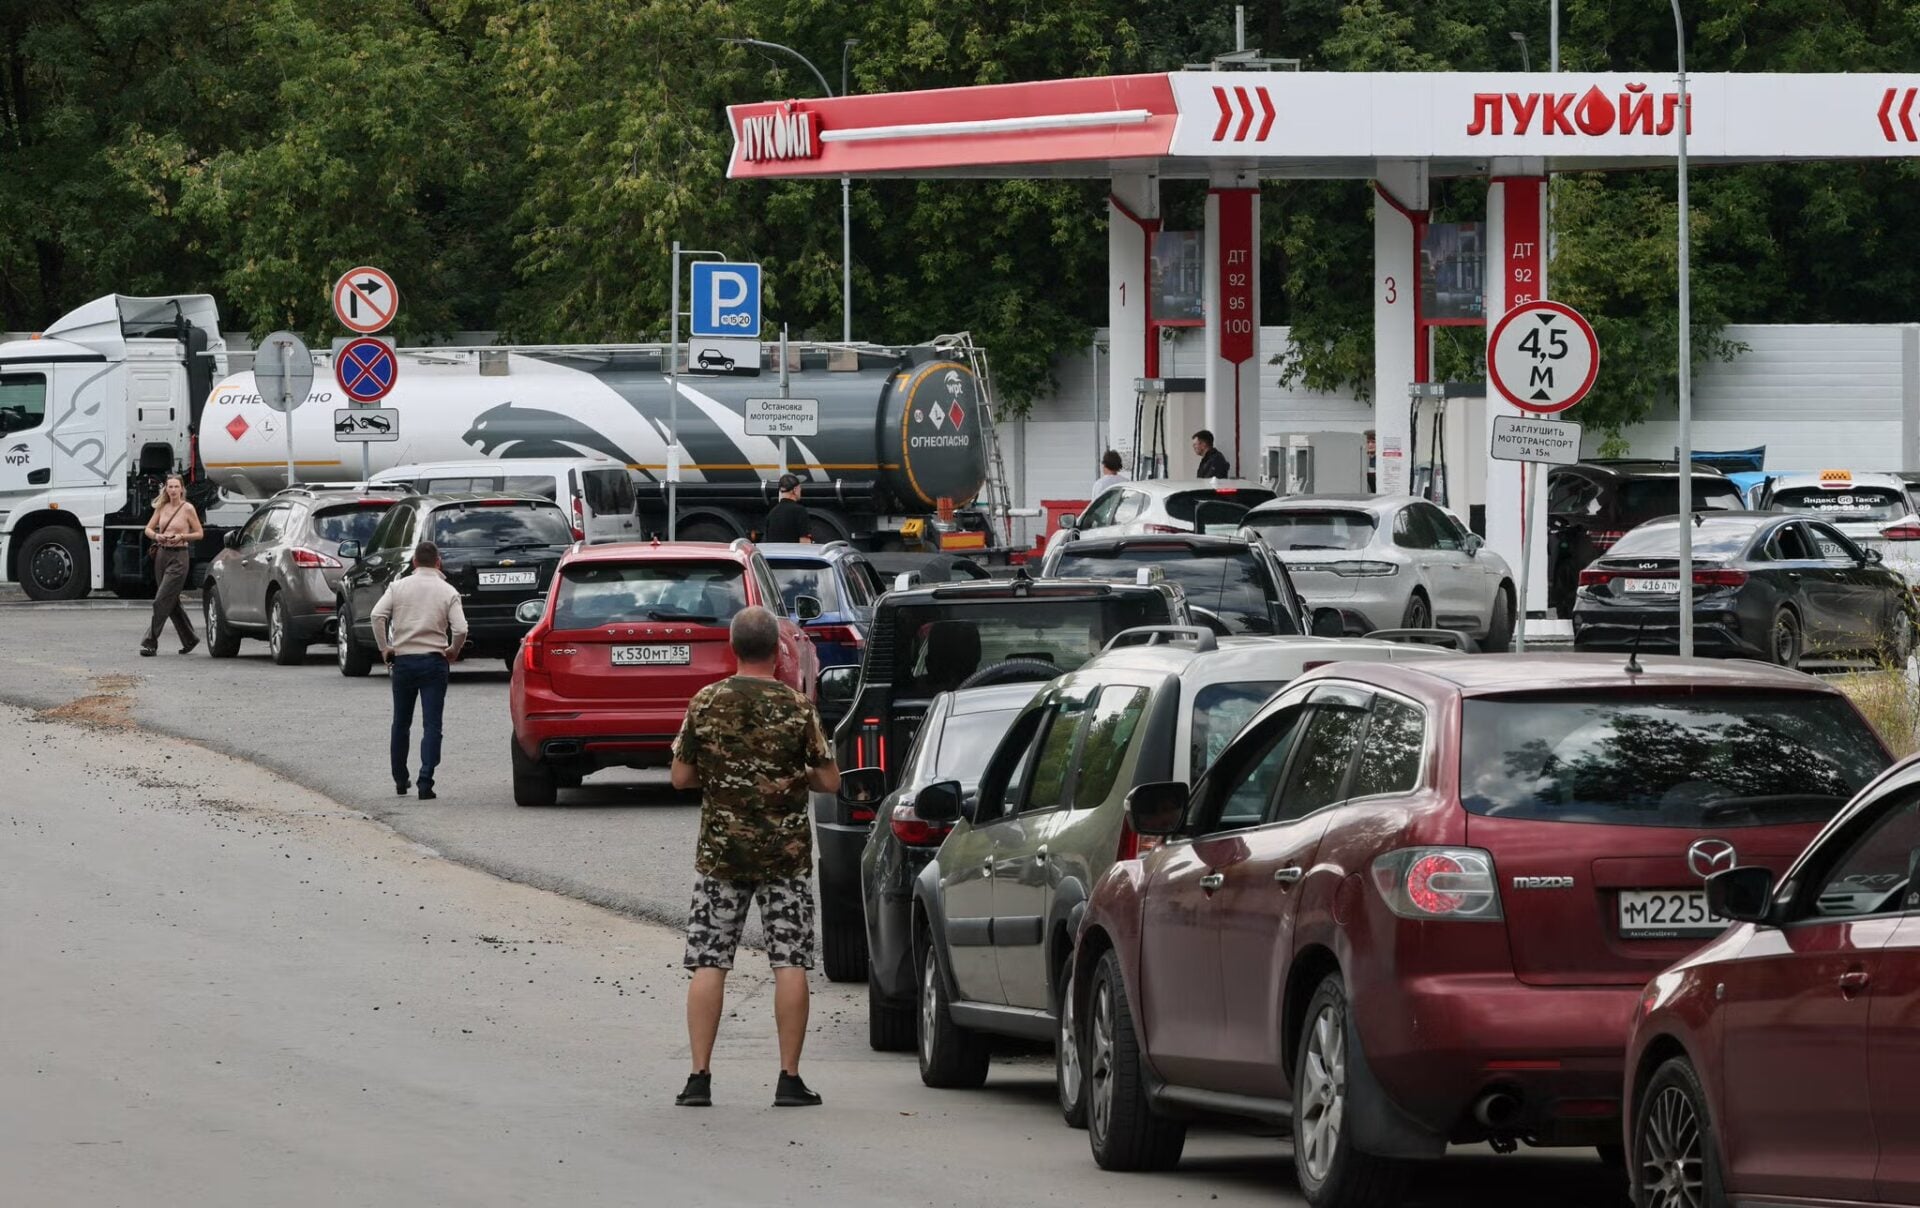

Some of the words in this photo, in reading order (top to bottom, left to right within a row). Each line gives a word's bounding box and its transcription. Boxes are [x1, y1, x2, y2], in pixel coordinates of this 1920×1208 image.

[1466, 83, 1692, 136] ЛУКОЙЛ
[742, 102, 811, 161] ЛУКОЙЛ
[1227, 250, 1247, 264] ДТ
[1513, 242, 1534, 259] ДТ
[1229, 273, 1246, 286] 92
[1514, 268, 1532, 282] 92
[1119, 281, 1126, 306] 1
[1385, 276, 1397, 304] 3
[711, 271, 748, 327] P
[1229, 296, 1245, 310] 95
[739, 315, 750, 324] 20
[1224, 319, 1251, 334] 100
[1518, 328, 1568, 364] 4,5
[1530, 366, 1553, 388] М
[946, 383, 963, 398] wpt
[219, 392, 332, 405] ОГНЕНО
[761, 401, 803, 411] Остановка
[750, 413, 814, 422] мототранспорта
[1510, 424, 1565, 437] ЗАГЛУШИТЬ
[911, 435, 970, 448] ОГНЕОПАСНО
[1498, 434, 1574, 449] МОТОТРАНСПОРТ
[1520, 447, 1531, 455] ЗА
[5, 454, 30, 467] wpt
[616, 648, 669, 660] К530МТ
[672, 647, 685, 656] 35
[1513, 876, 1574, 888] mazda
